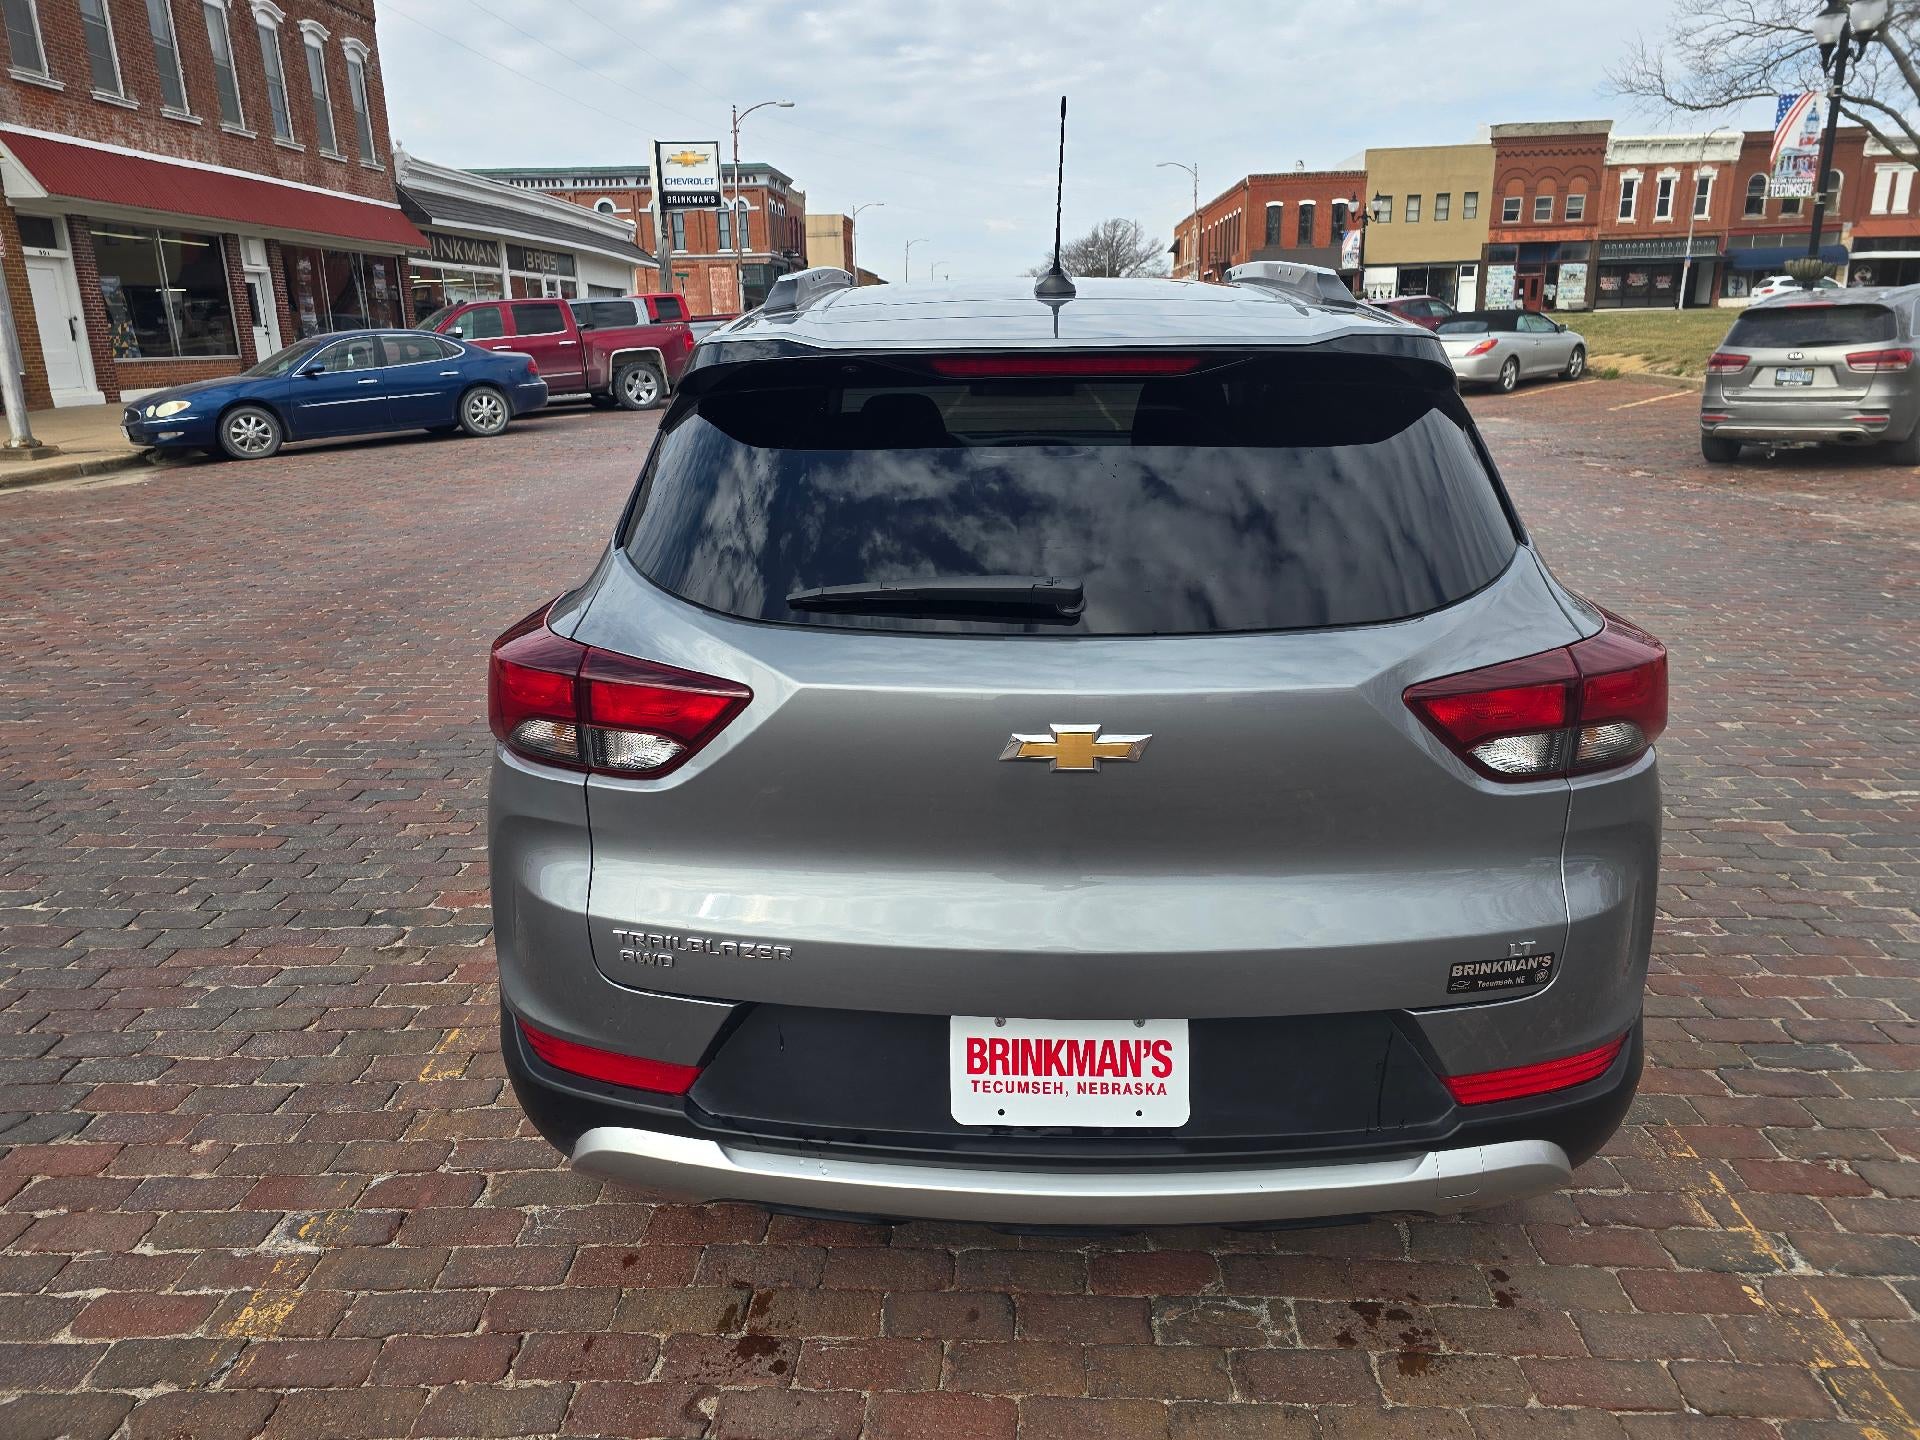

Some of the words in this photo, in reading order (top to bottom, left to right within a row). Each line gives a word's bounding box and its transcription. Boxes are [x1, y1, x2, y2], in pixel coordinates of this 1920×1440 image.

[664, 177, 714, 185] CHEVROLET
[1770, 182, 1812, 197] TECUMSEH
[667, 195, 716, 204] BRINKMAN'S
[409, 236, 499, 264] INKMAN
[526, 251, 557, 271] BROS
[612, 928, 793, 961] TRAILBLAZER
[1509, 940, 1537, 957] LT
[619, 949, 674, 968] AWD
[1451, 955, 1552, 977] BRINKMAN'S
[1515, 975, 1526, 985] NE
[966, 1037, 1173, 1078] BRINKMAN'S
[971, 1080, 1069, 1097] TECUMSEH,
[1076, 1081, 1168, 1096] NEBRASKA
